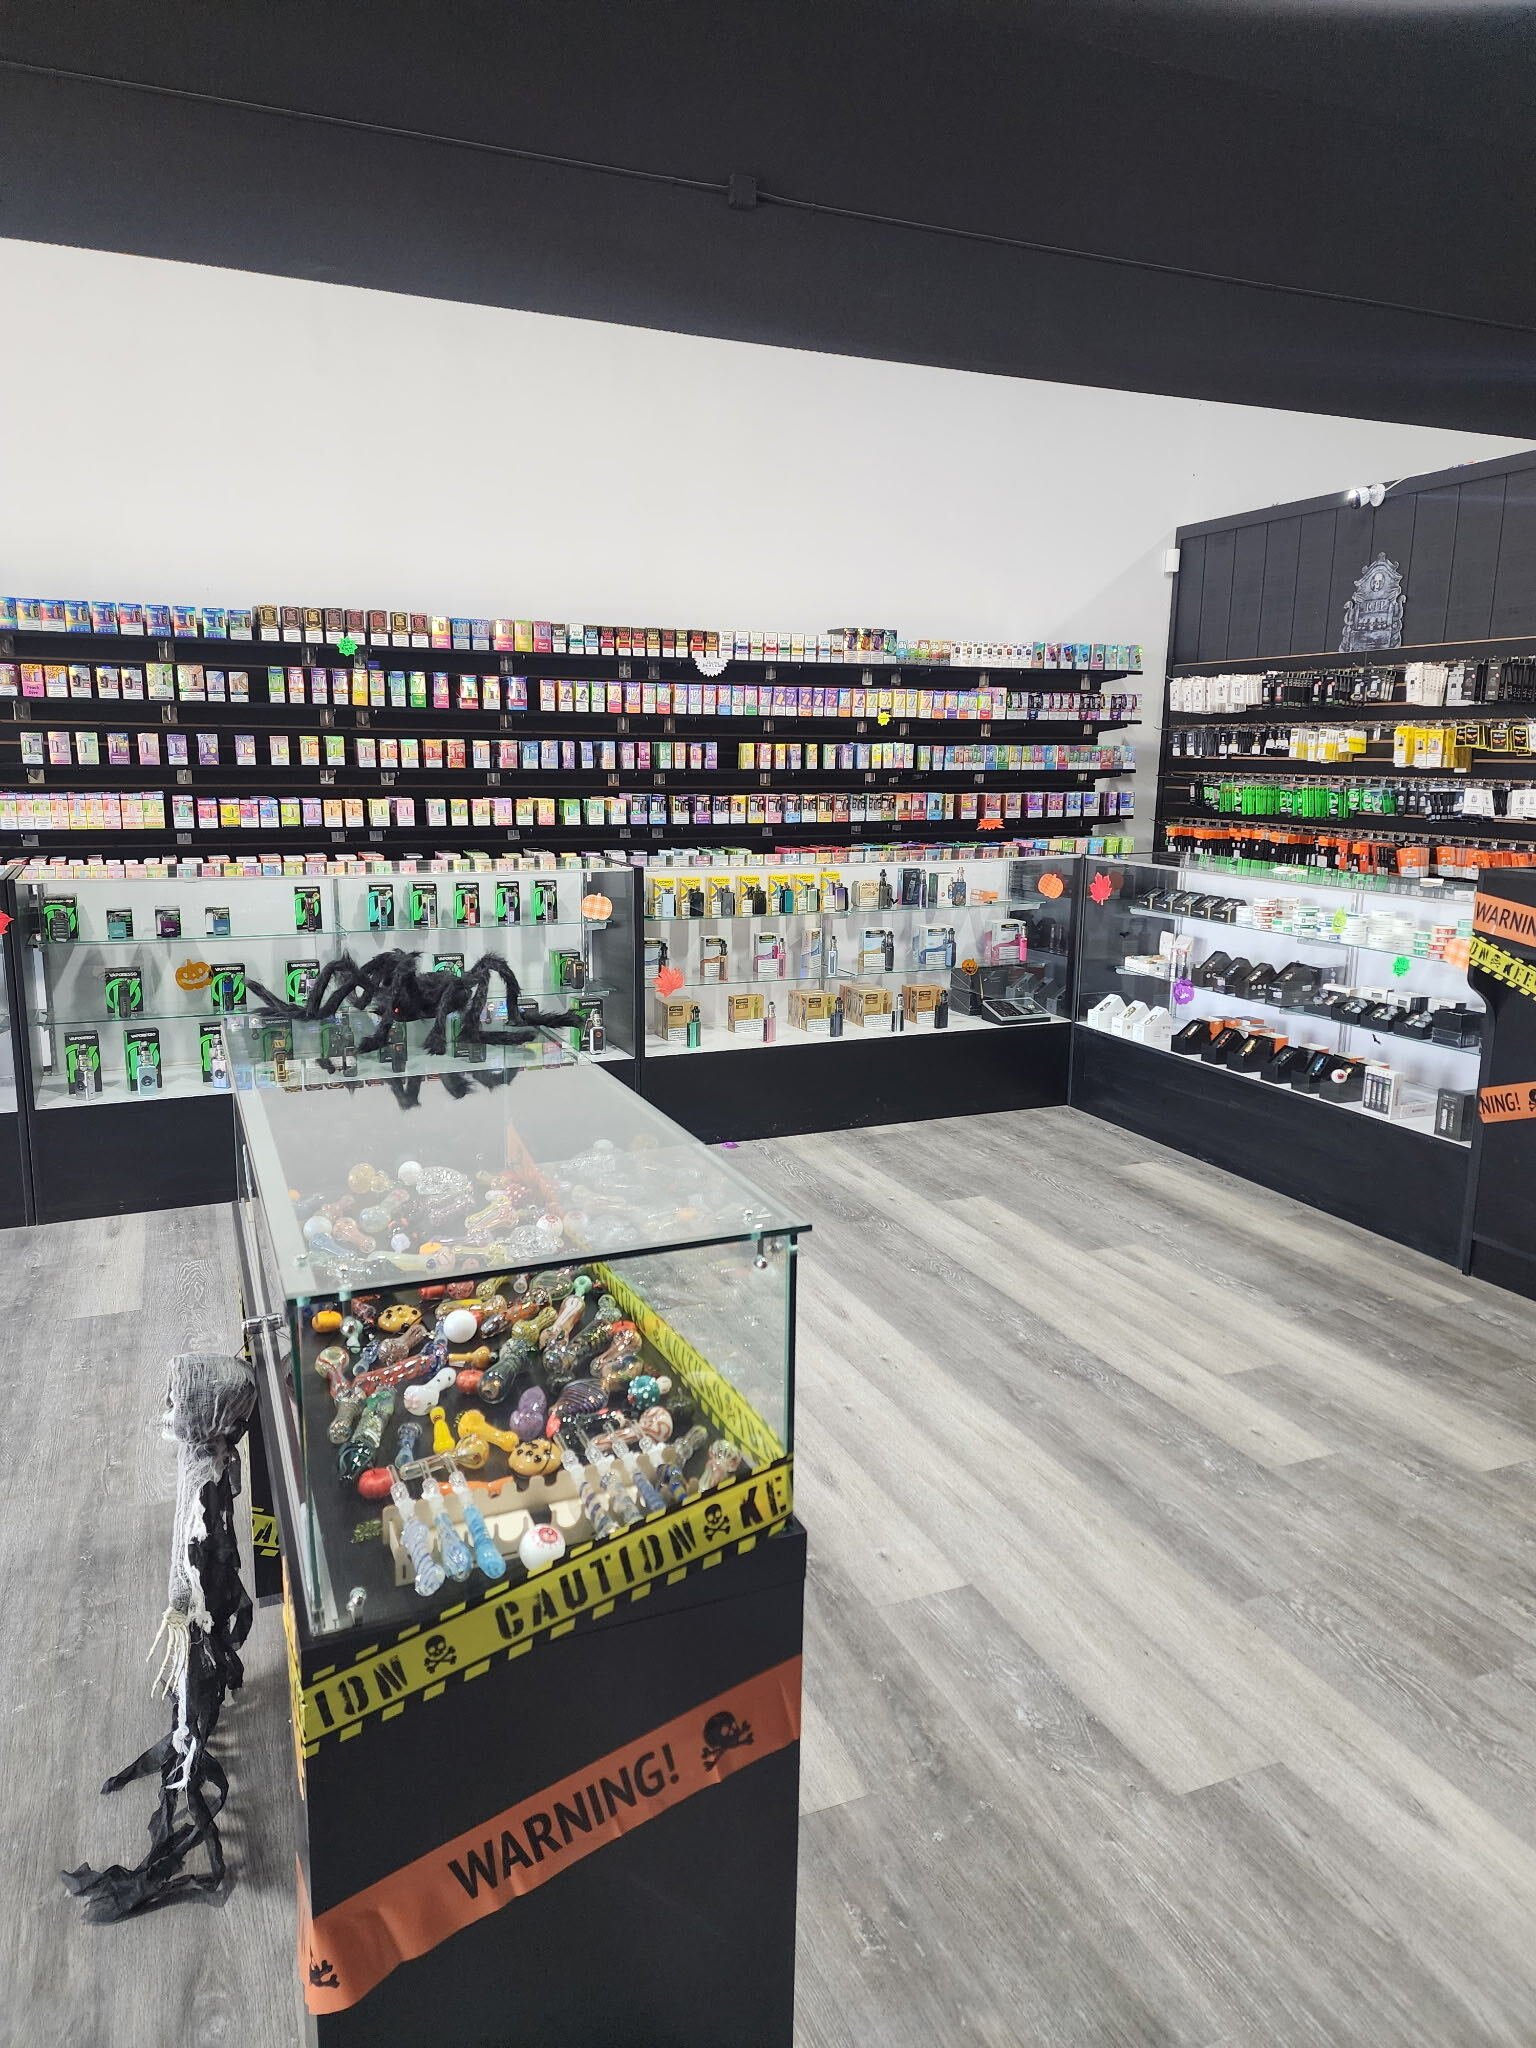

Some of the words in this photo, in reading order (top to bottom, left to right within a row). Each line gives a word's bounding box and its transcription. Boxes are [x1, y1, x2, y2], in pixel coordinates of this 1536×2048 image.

[1503, 963, 1536, 989] KEE
[1480, 1092, 1520, 1114] NING!
[303, 1655, 408, 1737] ION
[495, 1517, 696, 1639] CAUTION
[740, 1470, 793, 1529] KE
[448, 1744, 679, 1899] WARNING!
